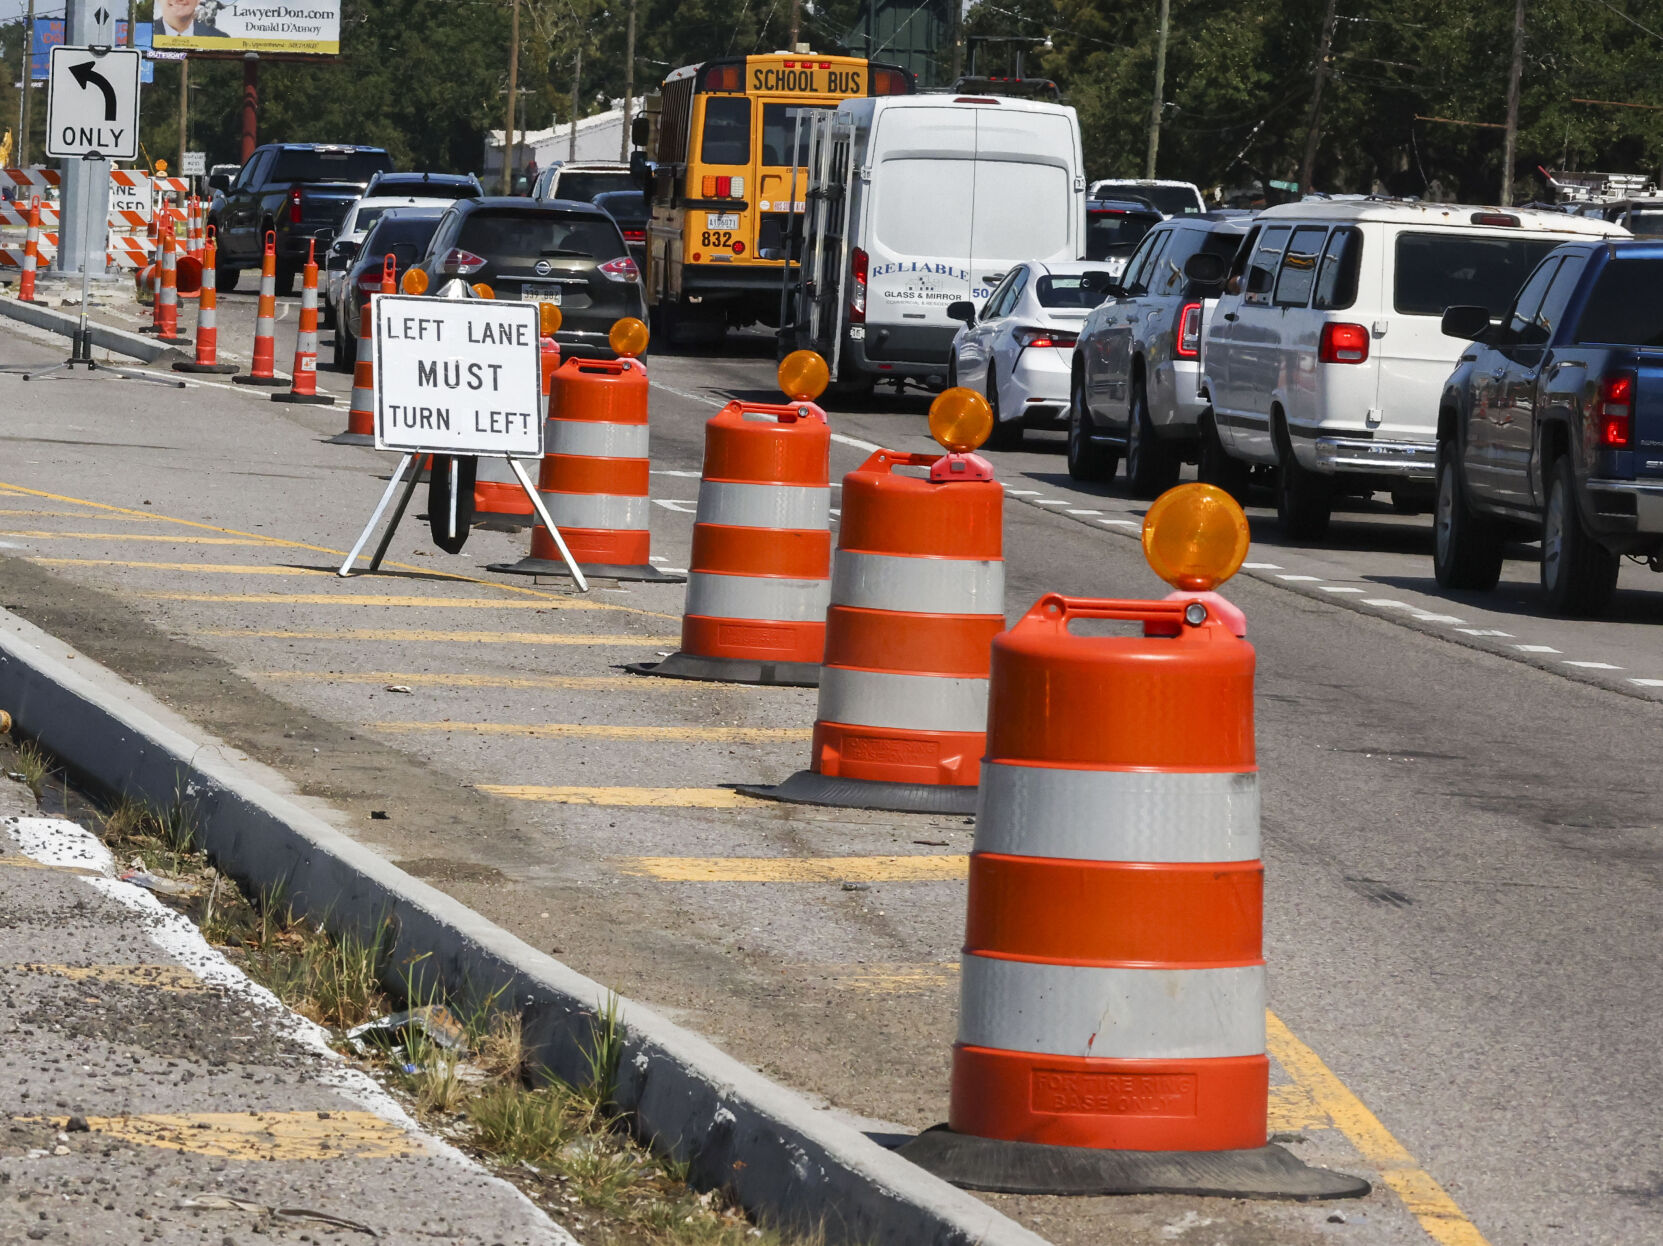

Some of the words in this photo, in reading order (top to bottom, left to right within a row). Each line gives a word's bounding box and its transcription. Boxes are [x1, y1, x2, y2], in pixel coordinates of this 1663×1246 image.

[232, 5, 335, 23] LawyerDon.com
[245, 22, 280, 32] Donald
[753, 68, 818, 92] SCHOOL
[827, 71, 861, 94] BUS
[62, 126, 124, 148] ONLY
[701, 231, 732, 247] 832
[872, 262, 969, 281] RELIABLE
[884, 291, 915, 299] GLASS
[925, 293, 962, 301] MIRROR
[972, 288, 990, 298] 50
[387, 317, 445, 342] LEFT
[467, 321, 529, 347] LANE
[418, 360, 503, 391] MUST
[388, 405, 450, 431] TURN
[475, 410, 531, 435] LEFT
[1038, 1074, 1078, 1092] FOR
[1084, 1076, 1134, 1092] TIRE
[1142, 1077, 1192, 1094] RING
[1054, 1094, 1108, 1110] BASE
[1116, 1094, 1181, 1112] ONLY
